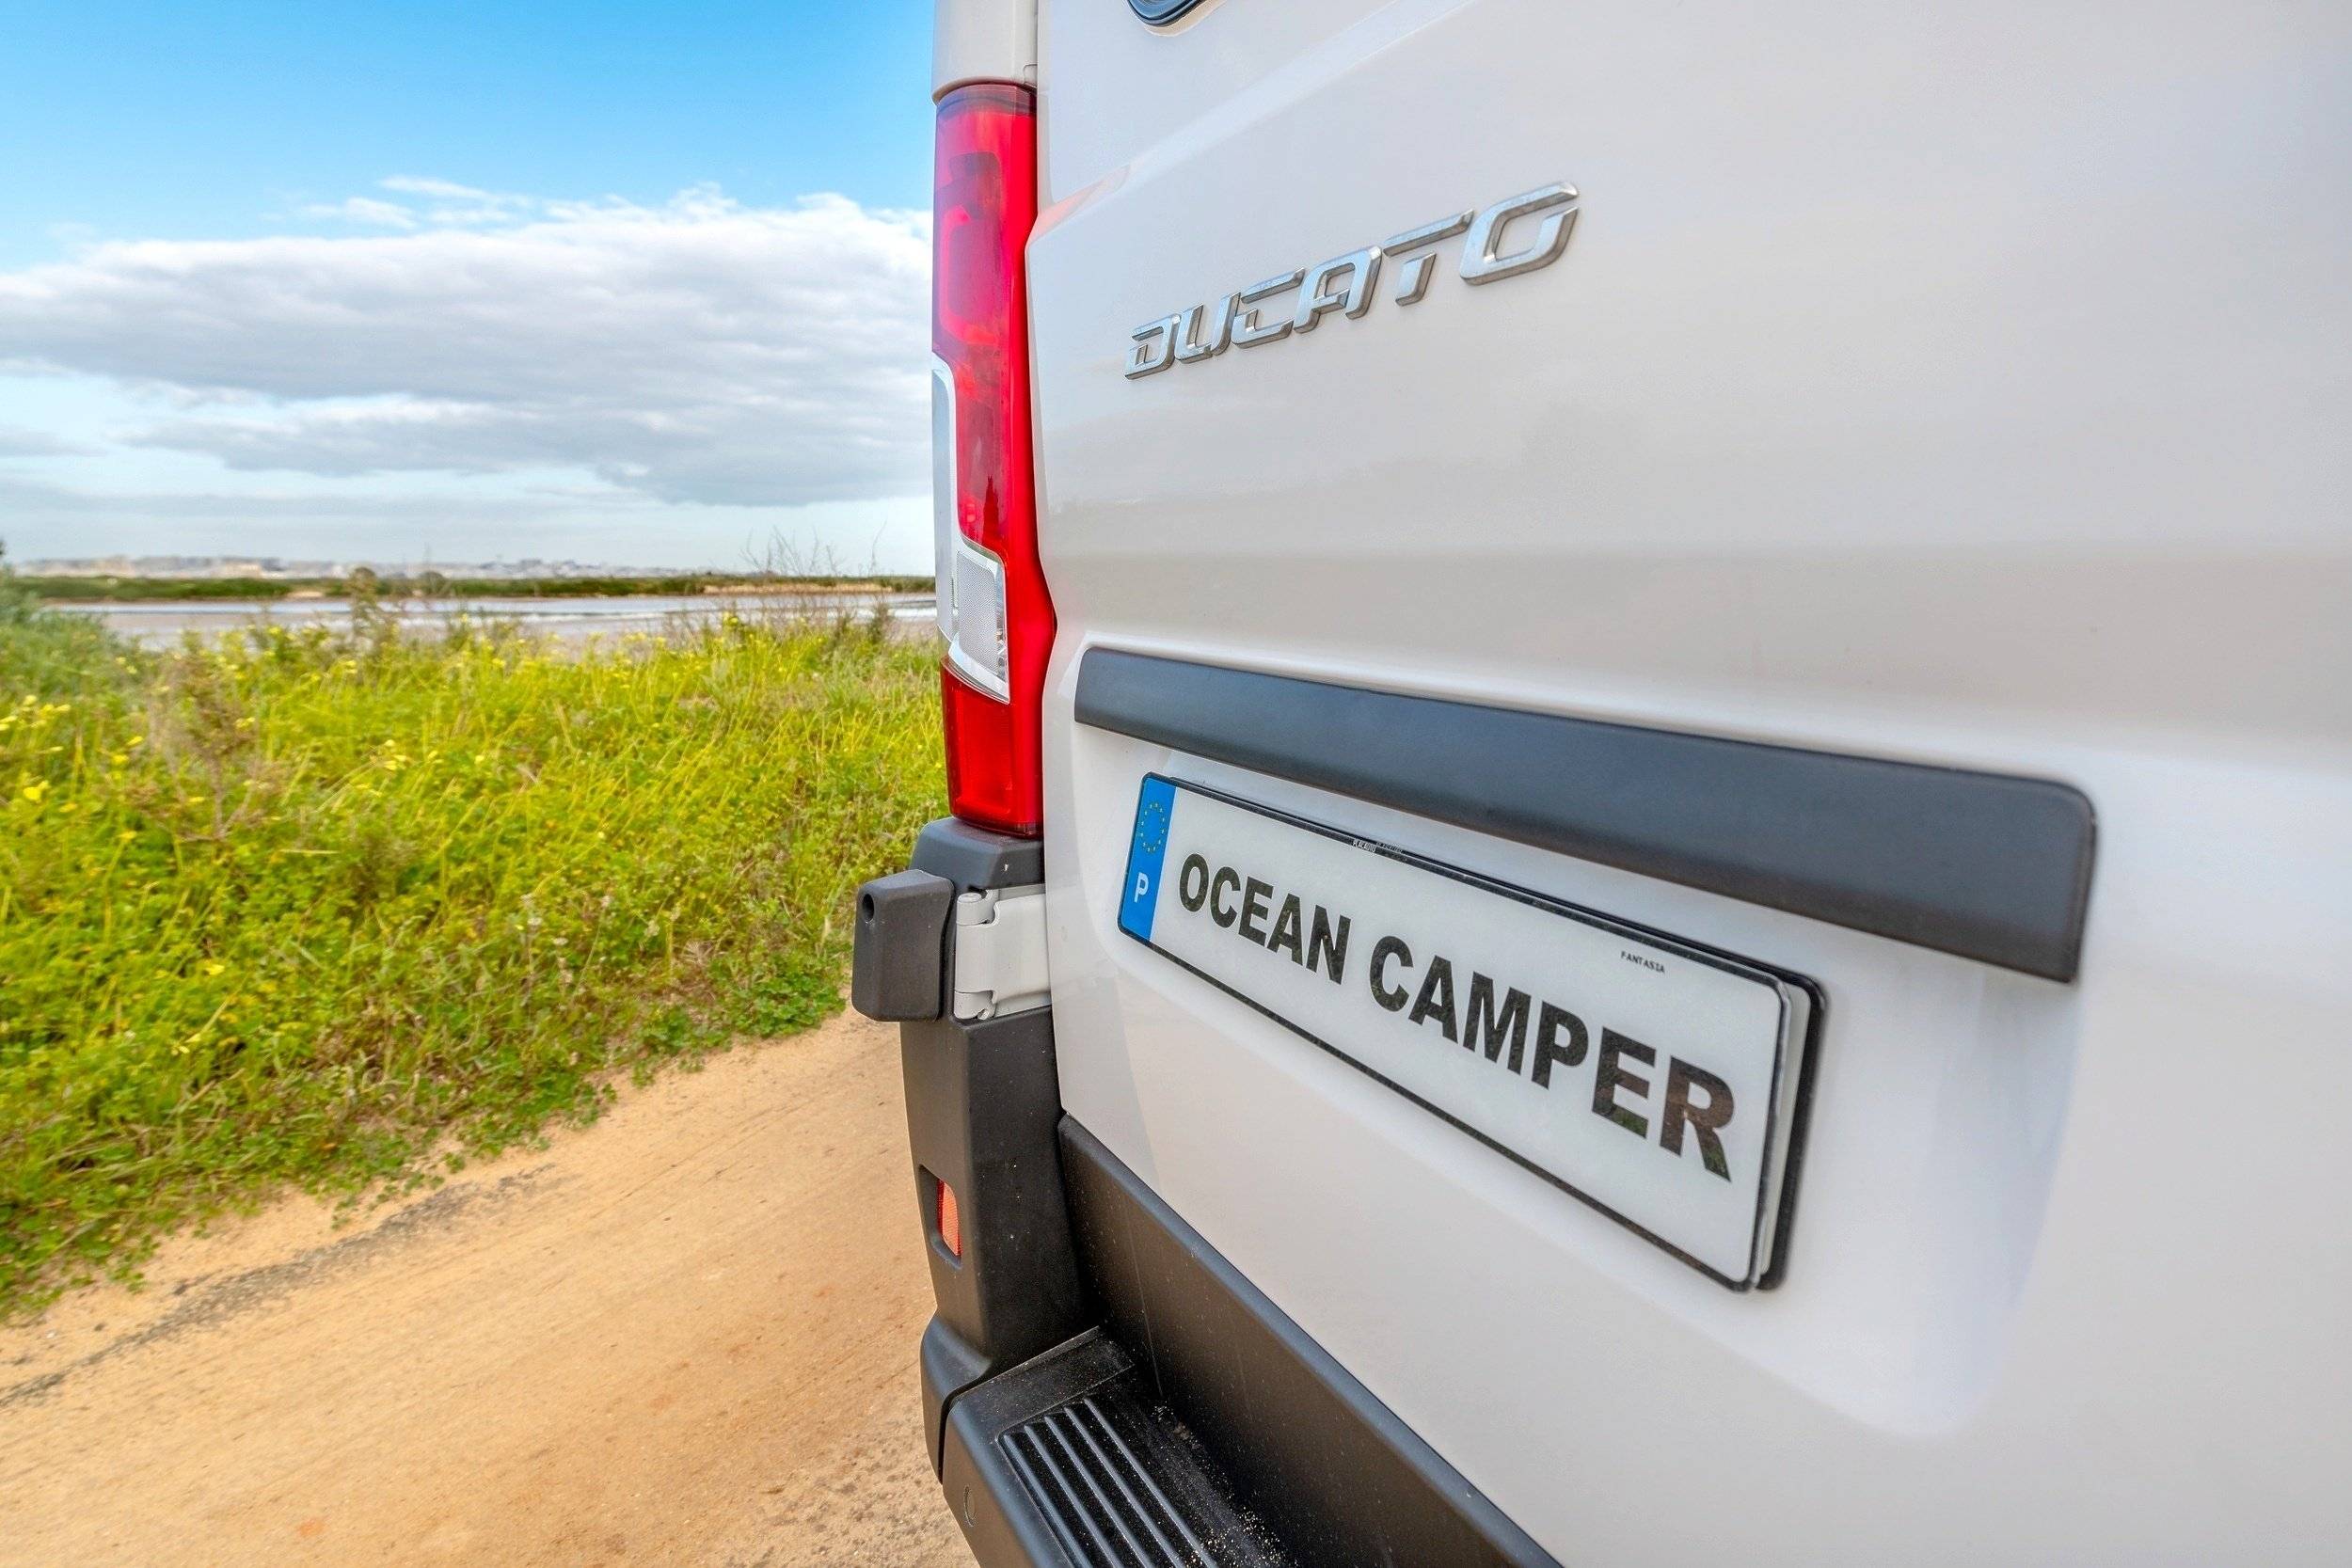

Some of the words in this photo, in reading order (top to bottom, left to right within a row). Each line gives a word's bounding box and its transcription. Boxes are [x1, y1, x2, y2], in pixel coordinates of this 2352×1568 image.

[1125, 181, 1579, 380] DUCATO
[1134, 871, 1149, 903] P
[1179, 853, 1352, 985] OCEAN
[1369, 935, 1733, 1183] CAMPER
[1620, 950, 1665, 974] FANTASIA
